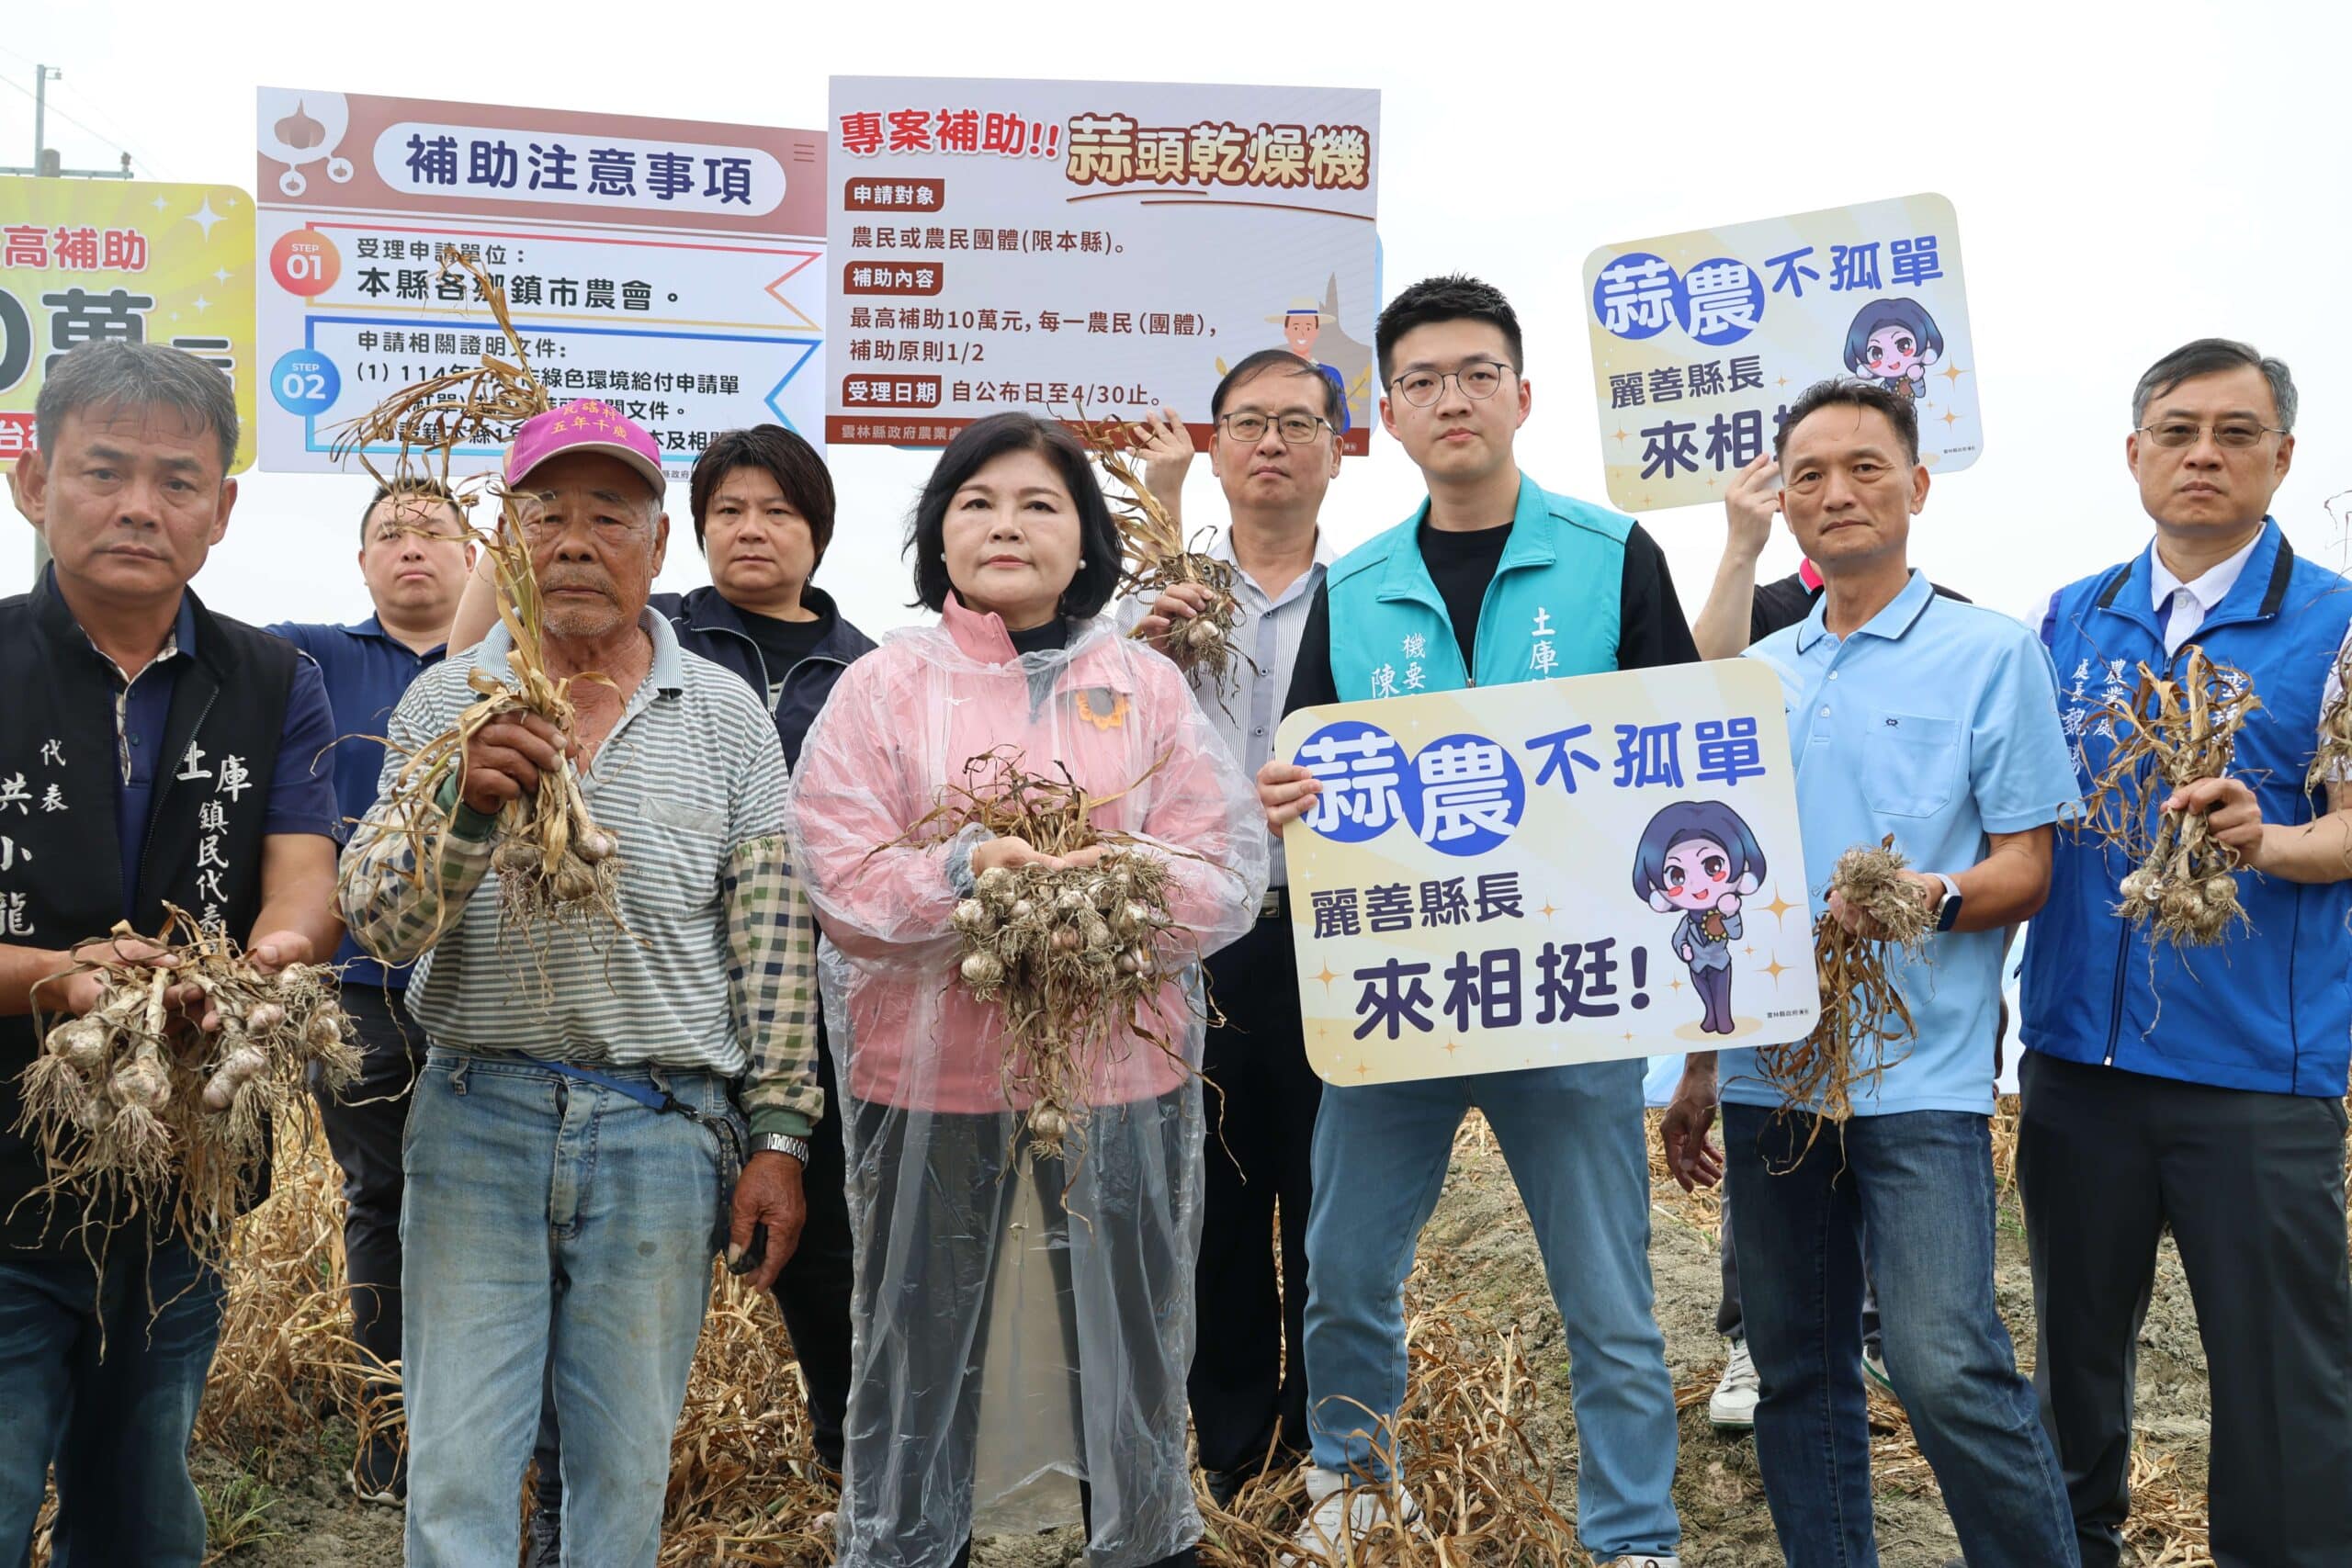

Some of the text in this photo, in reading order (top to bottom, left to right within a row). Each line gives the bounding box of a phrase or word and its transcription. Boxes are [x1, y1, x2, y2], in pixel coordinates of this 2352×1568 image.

[840, 107, 1371, 190] 專案補助!! 蒜頭乾燥機
[405, 132, 753, 208] 補助注意事項
[854, 185, 935, 207] 申請對象
[291, 243, 320, 253] STEP
[851, 226, 1125, 254] 農民或農民團體(限本縣)。
[287, 254, 322, 280] 01
[853, 268, 934, 290] 補助內容
[849, 339, 985, 365] 補助原則1/2
[291, 363, 320, 372] STEP
[281, 375, 326, 400] 02
[847, 380, 938, 404] 受理日期
[1609, 355, 1765, 410] 麗善縣長
[1371, 663, 1400, 698] 陳
[40, 738, 69, 813] 代表
[1310, 872, 1525, 939] 麗善縣長
[1351, 937, 1649, 1041] 來相挺!
